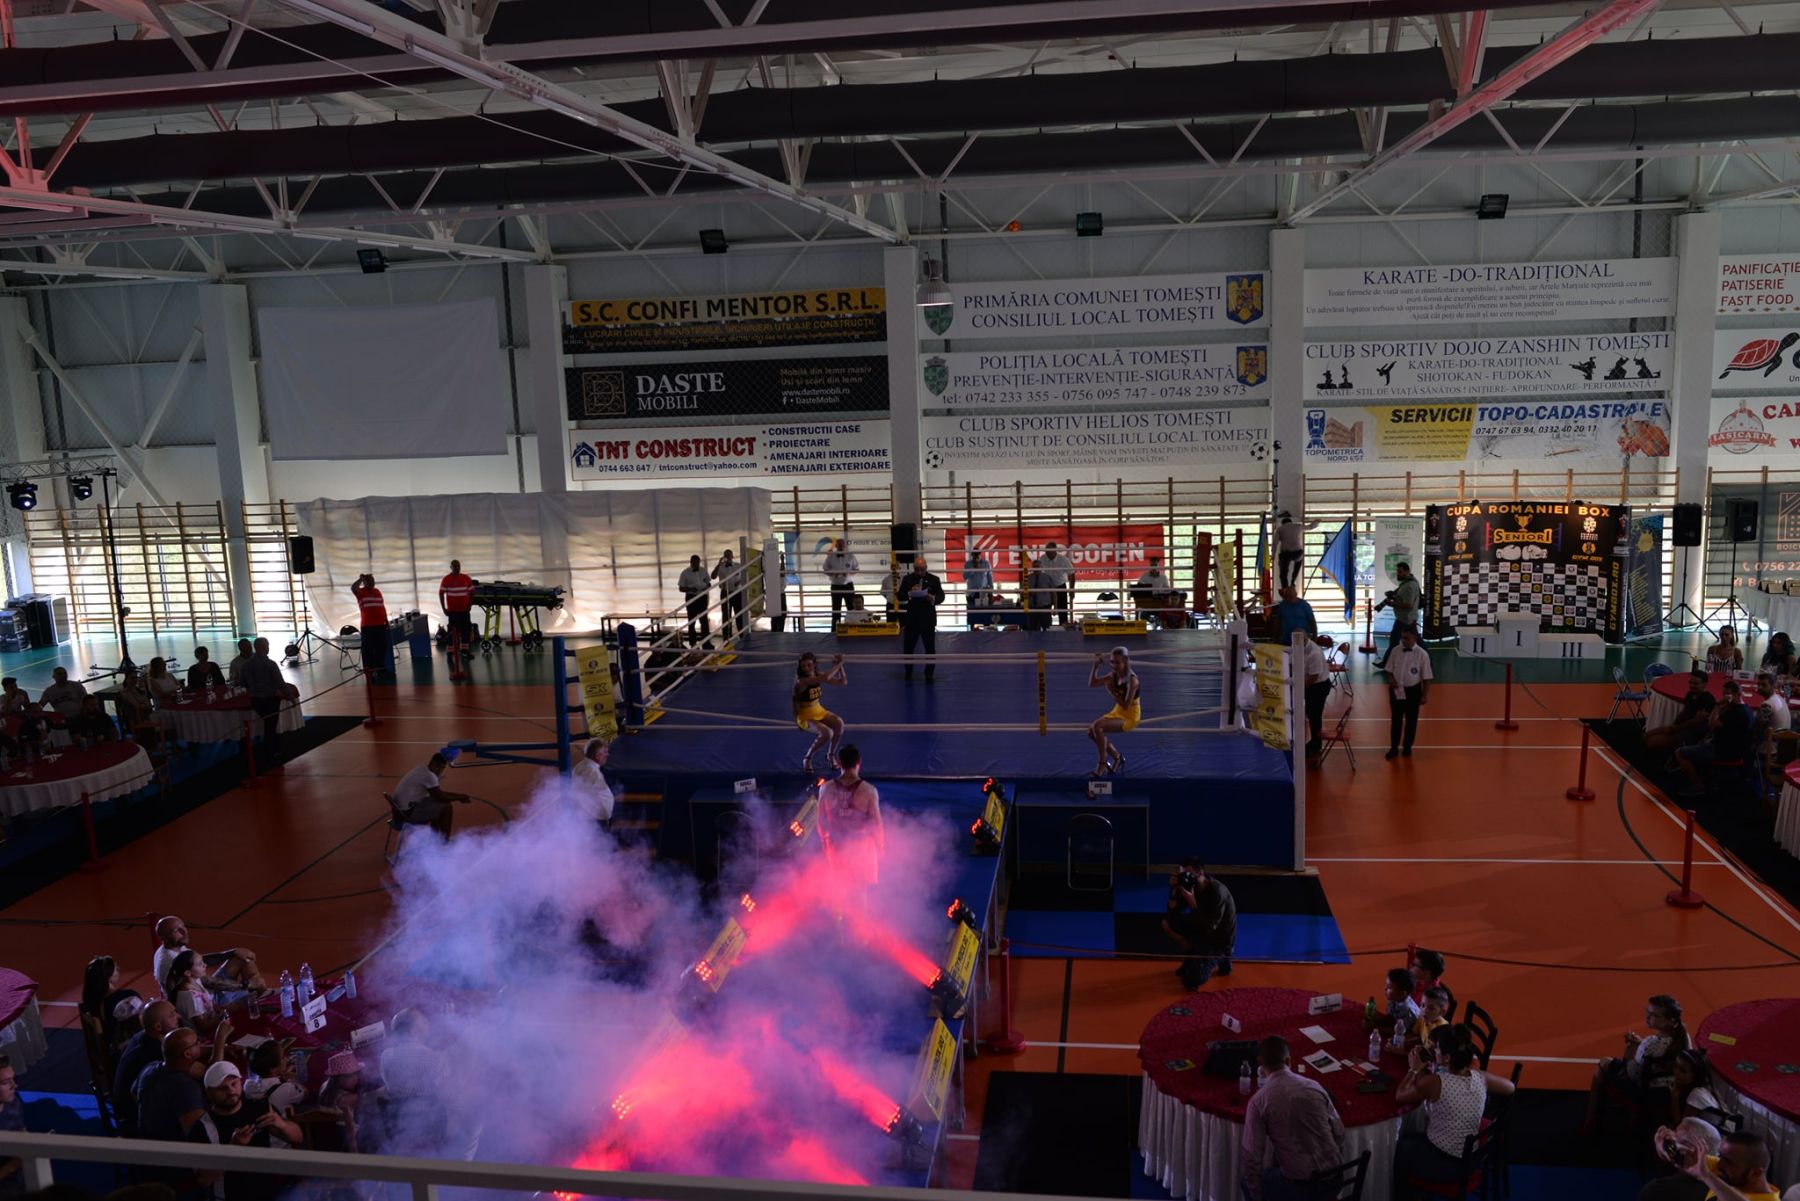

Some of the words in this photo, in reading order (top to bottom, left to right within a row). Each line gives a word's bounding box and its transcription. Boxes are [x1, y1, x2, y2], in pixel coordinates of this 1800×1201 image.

[1364, 269, 1438, 285] KARATE
[1722, 279, 1785, 291] PATISERIE
[579, 302, 620, 322] S.C.
[627, 300, 698, 321] CONFI
[706, 295, 809, 318] MENTOR
[815, 291, 880, 313] S.R.L.
[964, 291, 1051, 309] PRIMĂRIA
[1054, 289, 1138, 306] COMUNEI
[1721, 295, 1753, 306] FAST
[1757, 294, 1794, 305] FOOD
[971, 313, 1066, 329] CONSILIUL
[1071, 310, 1131, 326] LOCAL
[1306, 343, 1356, 359] CLUB
[1361, 342, 1438, 358] SPORTIV
[1443, 340, 1491, 356] DOJO
[1497, 337, 1581, 354] ZANSHIN
[980, 355, 1048, 371] POLIȚIA
[1053, 350, 1125, 368] LOCALĂ
[1408, 356, 1562, 371] KARATE-DO-TRADIȚIONAL
[1417, 371, 1480, 383] SHOTOKAN
[1492, 369, 1552, 381] FUDOKAN
[635, 372, 727, 396] DASTE
[1376, 387, 1389, 395] DE
[795, 396, 840, 405] DasteMobili
[966, 392, 996, 403] 0742
[1000, 391, 1022, 402] 233
[1028, 390, 1050, 402] 355
[1062, 389, 1093, 401] 0756
[1097, 389, 1120, 400] 095
[1125, 388, 1148, 399] 747
[1160, 386, 1191, 398] 0748
[1196, 386, 1219, 397] 239
[1223, 385, 1247, 396] 873
[637, 395, 700, 411] MOBILI
[959, 417, 1006, 431] CLUB
[1011, 416, 1082, 431] SPORTIV
[1086, 414, 1149, 429] HELIOS
[1390, 407, 1472, 423] SERVICII
[769, 427, 833, 436] CONSTRUCTII
[835, 425, 861, 434] CASE
[1475, 427, 1497, 435] 0747
[1510, 426, 1521, 434] 63
[1538, 425, 1559, 433] 0332
[1573, 424, 1585, 432] 20
[769, 438, 831, 448] PROIECTARE
[926, 437, 965, 449] CLUB
[968, 435, 1040, 450] SUSȚINUT
[1043, 434, 1062, 446] DE
[1066, 433, 1145, 446] CONSILIUL
[1149, 431, 1199, 444] LOCAL
[594, 441, 631, 460] TNT
[636, 437, 757, 460] CONSTRUCT
[770, 450, 826, 461] AMENAJARI
[829, 448, 888, 459] INTERIOARE
[1305, 448, 1364, 456] TOPOMETRICA
[599, 465, 618, 473] 0744
[771, 463, 827, 473] AMENAJARI
[830, 461, 891, 471] EXTERIOARE
[1446, 505, 1483, 517] CUPA
[1488, 504, 1569, 515] ROMANIEI
[1578, 506, 1610, 518] BOX
[1776, 543, 1800, 551] BOIC
[1754, 561, 1785, 572] 0756
[1609, 560, 1621, 632] GYMBOX.RO
[1472, 637, 1486, 653] II
[1561, 642, 1584, 658] III
[313, 1018, 320, 1029] 8
